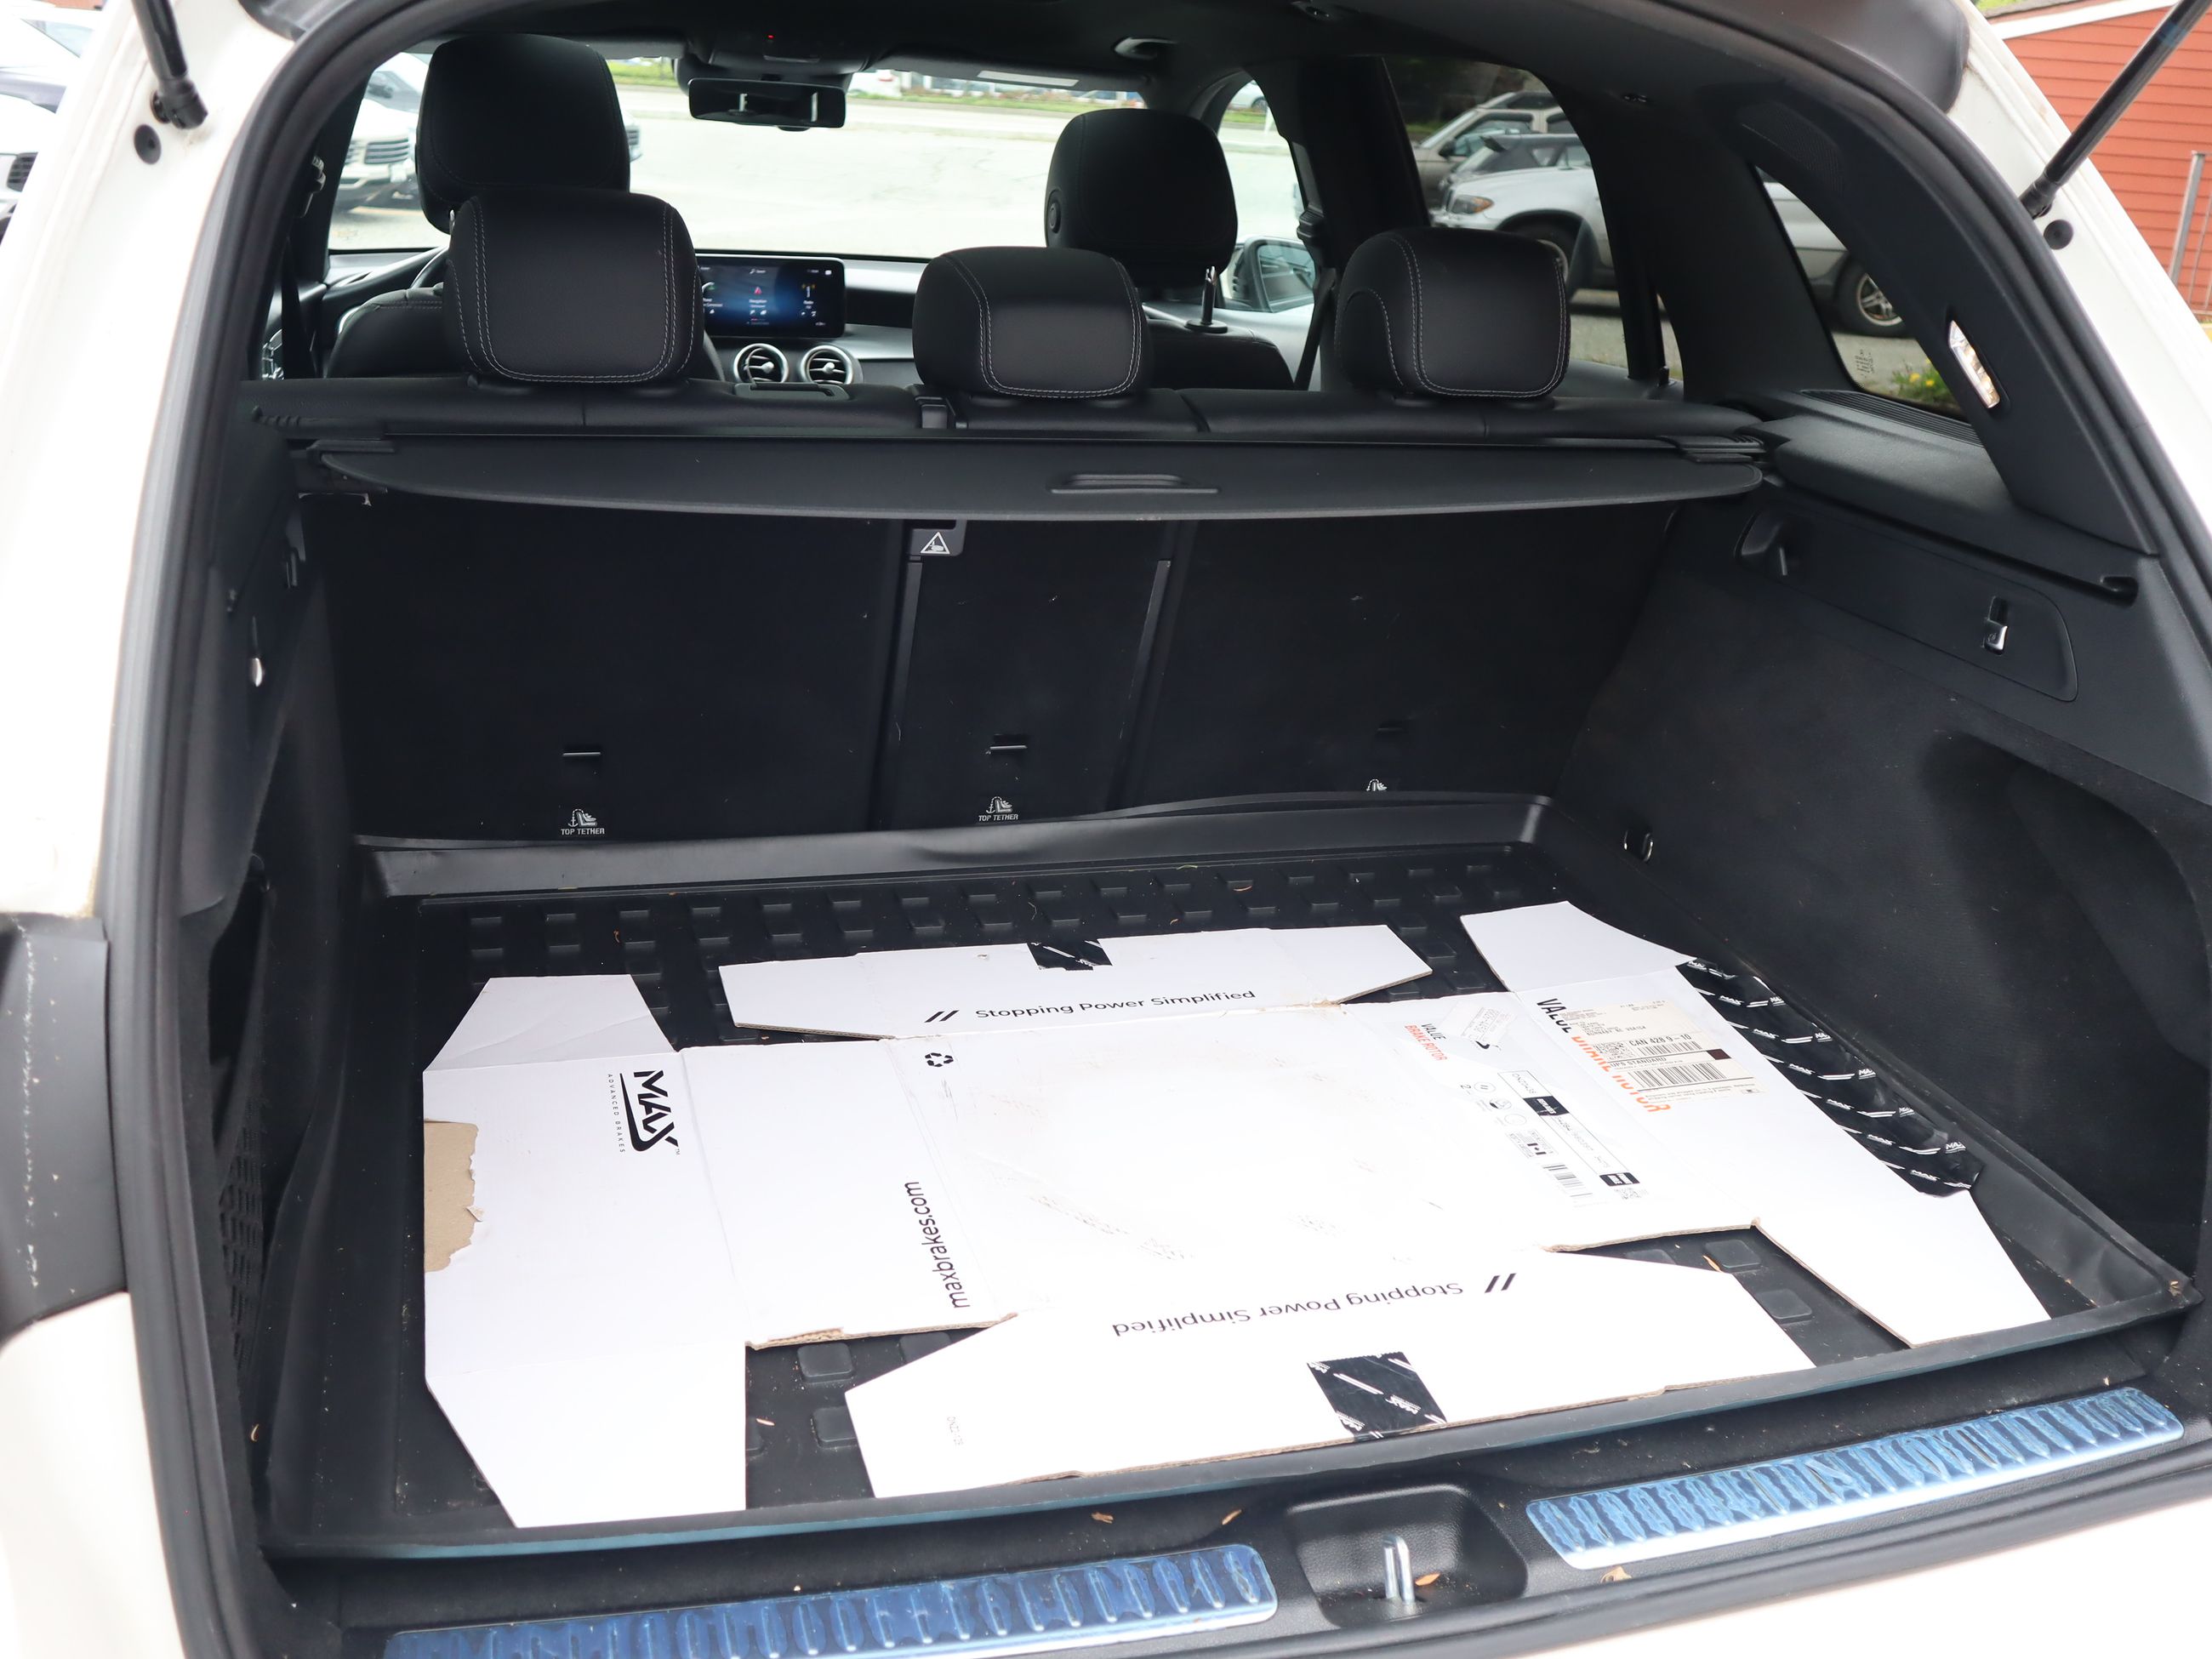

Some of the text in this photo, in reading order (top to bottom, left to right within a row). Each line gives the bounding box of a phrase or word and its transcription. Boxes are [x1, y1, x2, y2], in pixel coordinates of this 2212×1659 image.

[976, 990, 1256, 1018] Stopping Power Simplified
[1405, 1024, 1431, 1043] BRAKE
[1421, 1023, 1446, 1040] VALUE
[1628, 1039, 1649, 1047] CAN
[1627, 1057, 1668, 1066] STANDARD
[607, 1073, 625, 1153] ADVANCED BRAKES
[619, 1069, 679, 1151] MAX
[904, 1181, 971, 1308] maxbrakes.com
[1112, 1282, 1463, 1337] Stopping Power Simplified
